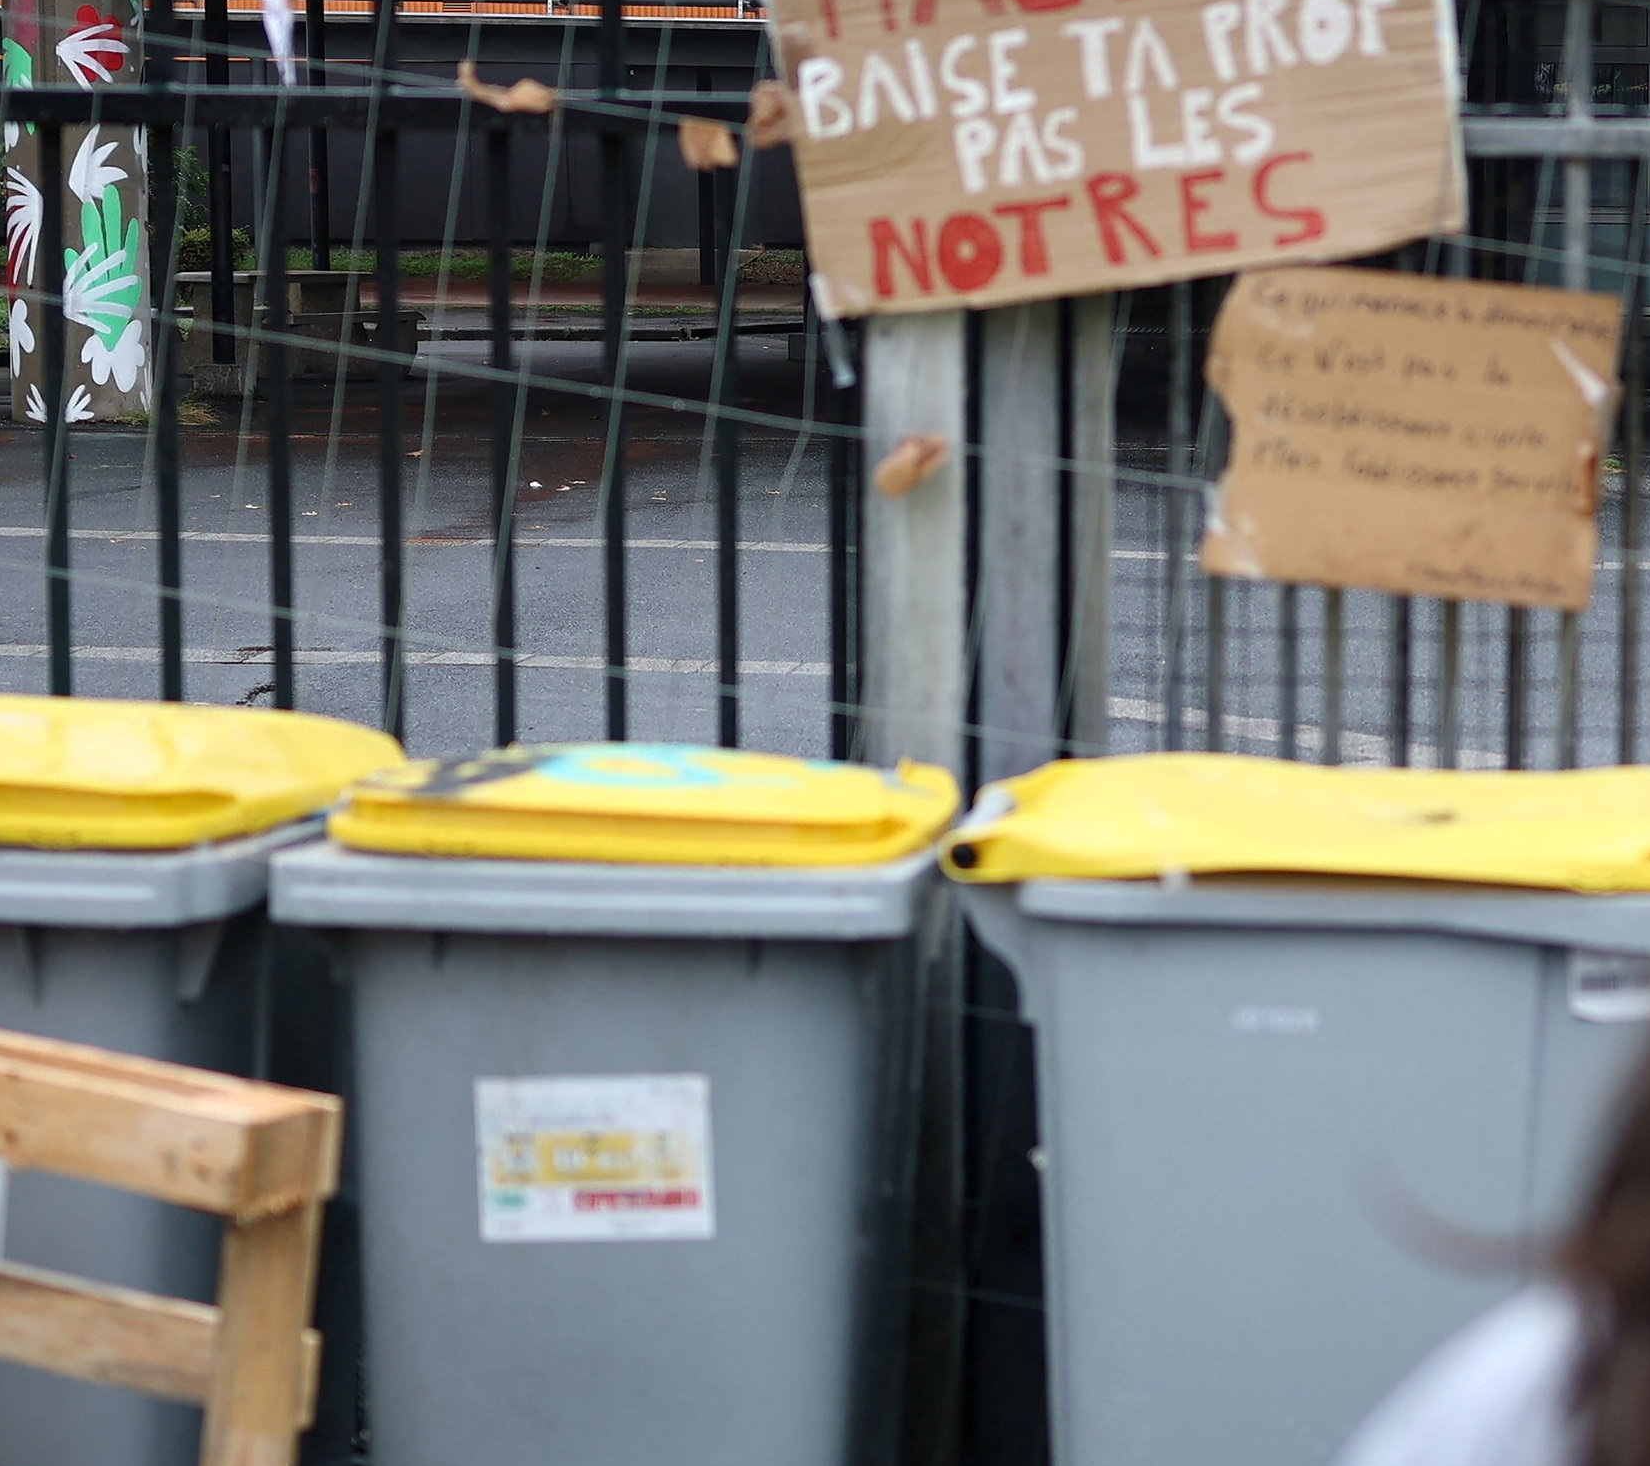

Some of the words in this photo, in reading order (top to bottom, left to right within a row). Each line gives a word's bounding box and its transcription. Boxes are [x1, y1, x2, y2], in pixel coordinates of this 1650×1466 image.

[797, 25, 1037, 138] BAISE
[1062, 16, 1178, 99] TA
[952, 108, 1084, 193] PAS
[1128, 85, 1275, 171] LES
[868, 151, 1326, 301] NOTRES
